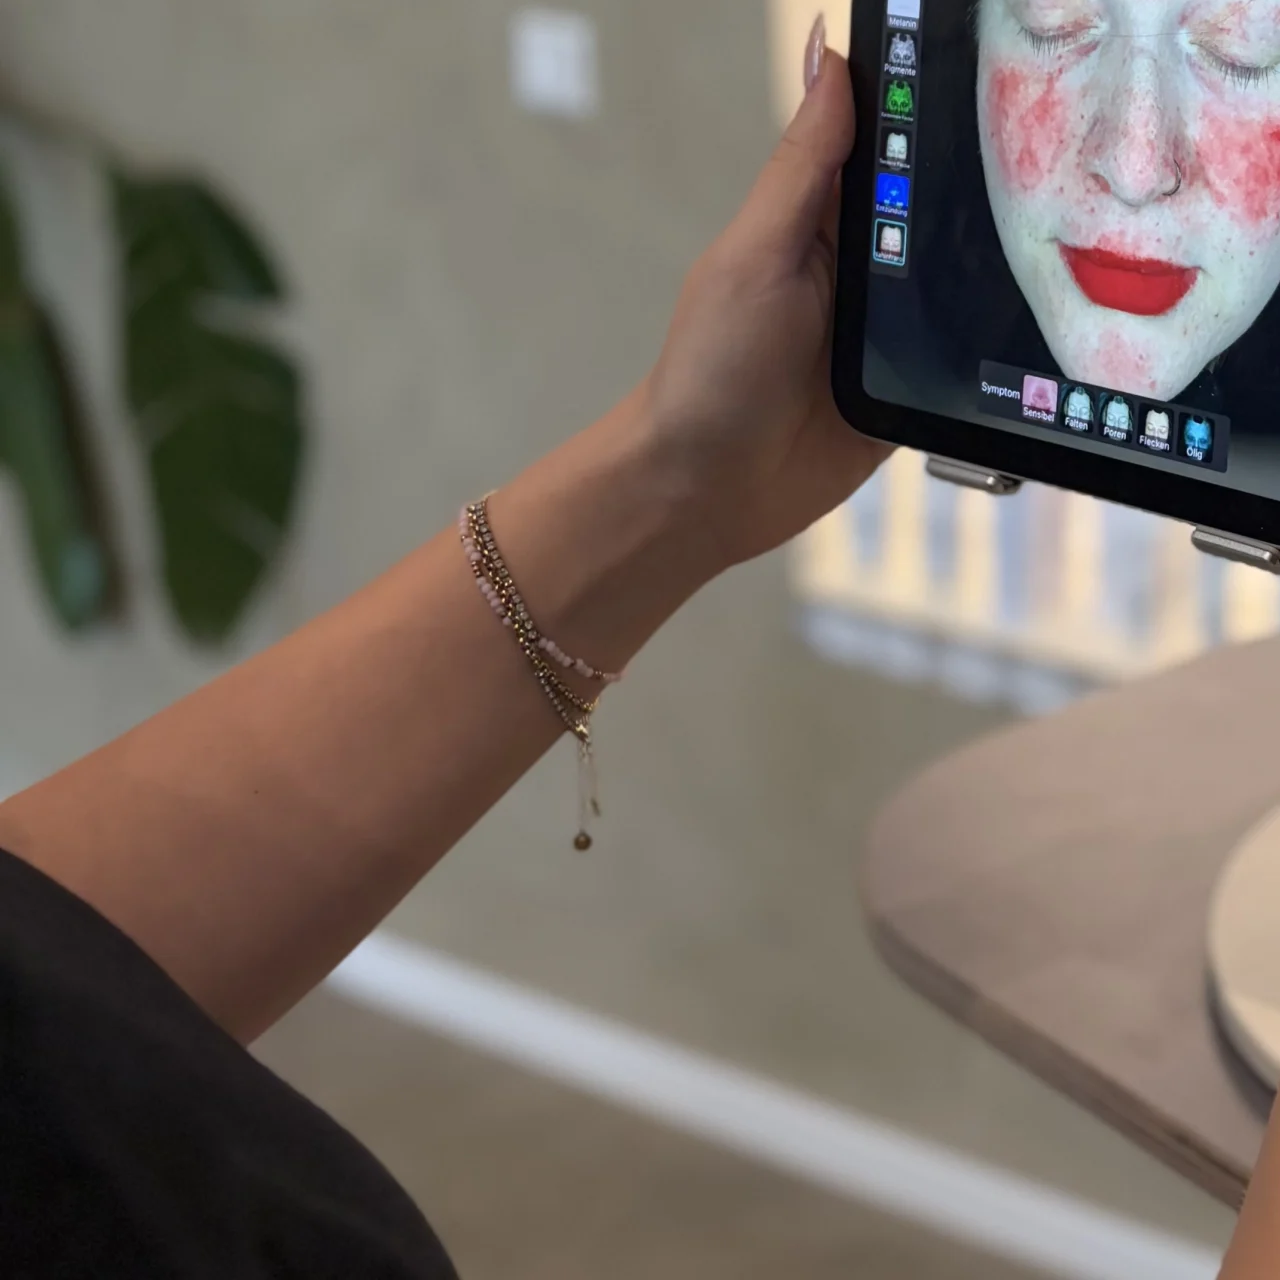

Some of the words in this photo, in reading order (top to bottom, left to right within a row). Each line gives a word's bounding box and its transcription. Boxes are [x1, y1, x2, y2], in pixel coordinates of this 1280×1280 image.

[889, 16, 917, 29] Melanin
[883, 63, 917, 77] Pigmente
[981, 381, 1021, 401] Symptom
[1023, 406, 1056, 423] Sensibel
[1064, 416, 1089, 431] Falten
[1103, 426, 1127, 440] Poren
[1139, 434, 1170, 452] Flecken
[1186, 446, 1203, 460] Ölig
